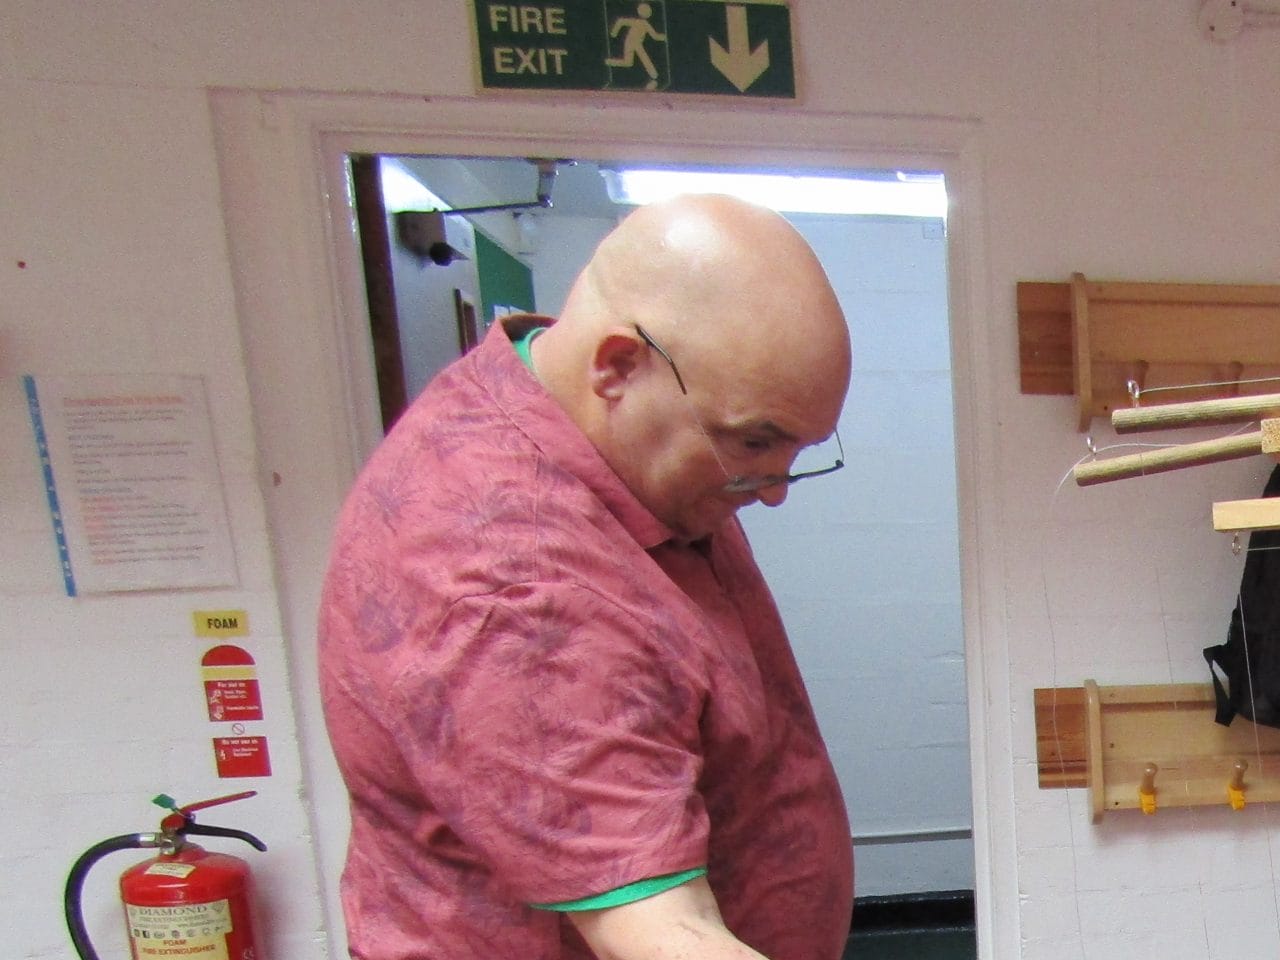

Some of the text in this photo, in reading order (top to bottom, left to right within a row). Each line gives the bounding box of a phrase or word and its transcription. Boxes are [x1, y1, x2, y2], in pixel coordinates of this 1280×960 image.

[489, 5, 567, 34] FIRE
[494, 47, 568, 75] EXIT
[207, 618, 238, 630] FOAM
[139, 905, 208, 917] DIAMOND
